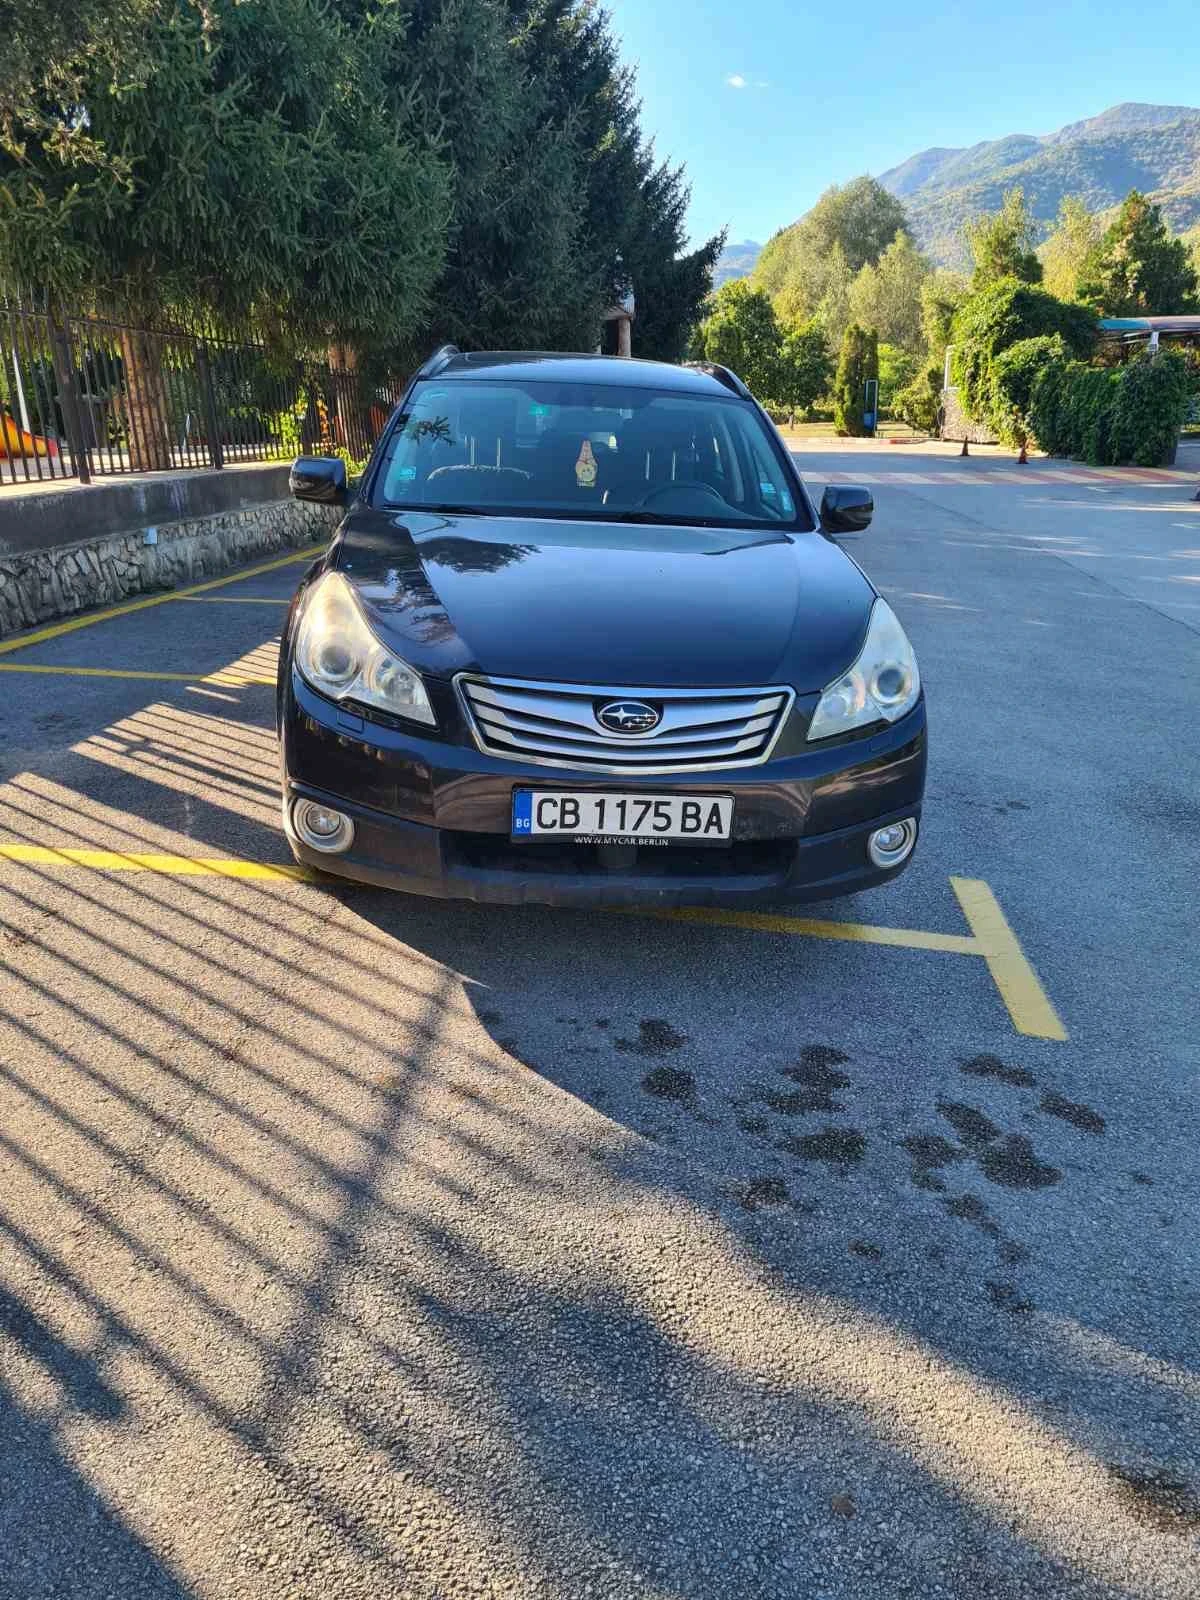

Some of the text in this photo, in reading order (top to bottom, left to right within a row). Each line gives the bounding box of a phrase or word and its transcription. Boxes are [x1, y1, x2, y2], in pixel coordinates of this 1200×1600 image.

[516, 819, 530, 828] BG
[536, 798, 724, 834] CB 1175 BA
